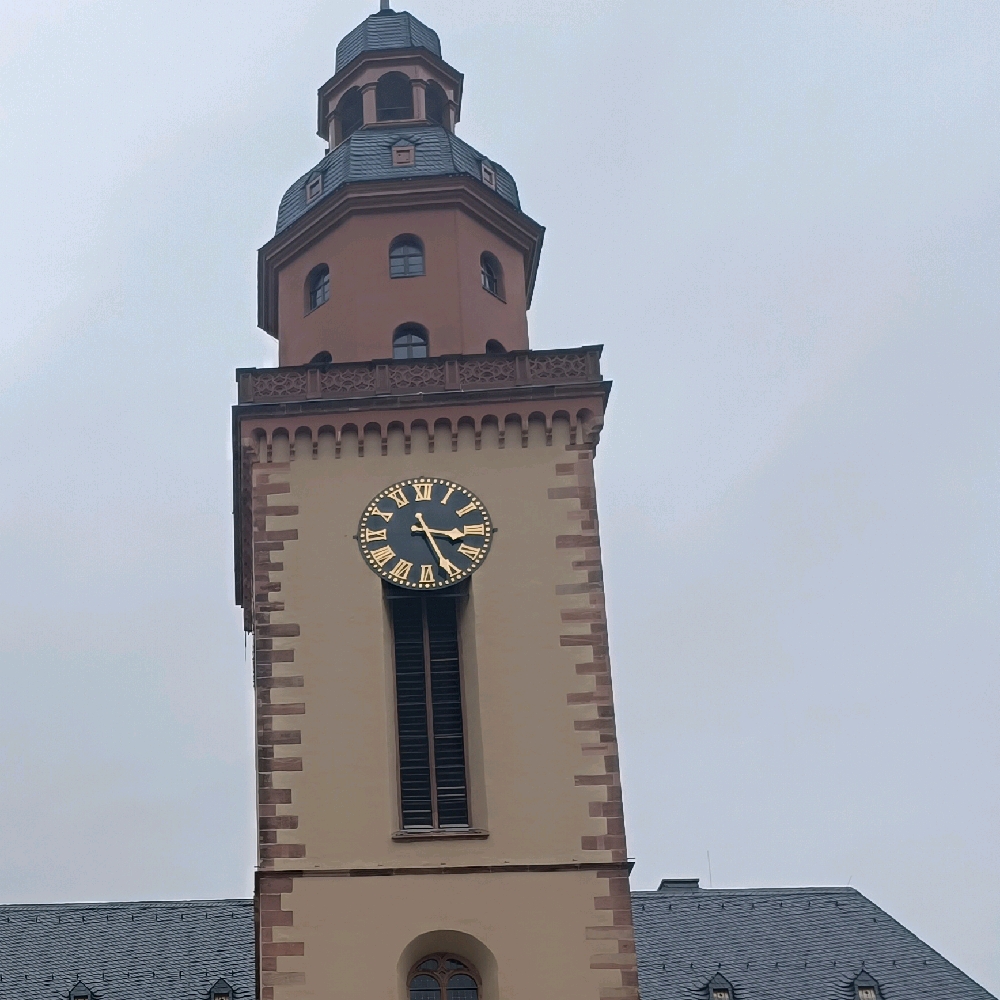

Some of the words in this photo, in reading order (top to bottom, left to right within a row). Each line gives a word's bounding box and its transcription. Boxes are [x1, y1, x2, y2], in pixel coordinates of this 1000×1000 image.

[387, 487, 410, 508] XI
[412, 483, 434, 501] XII
[440, 487, 455, 505] I
[371, 506, 394, 522] X
[456, 501, 478, 517] II
[366, 527, 387, 542] IX
[463, 523, 486, 536] III
